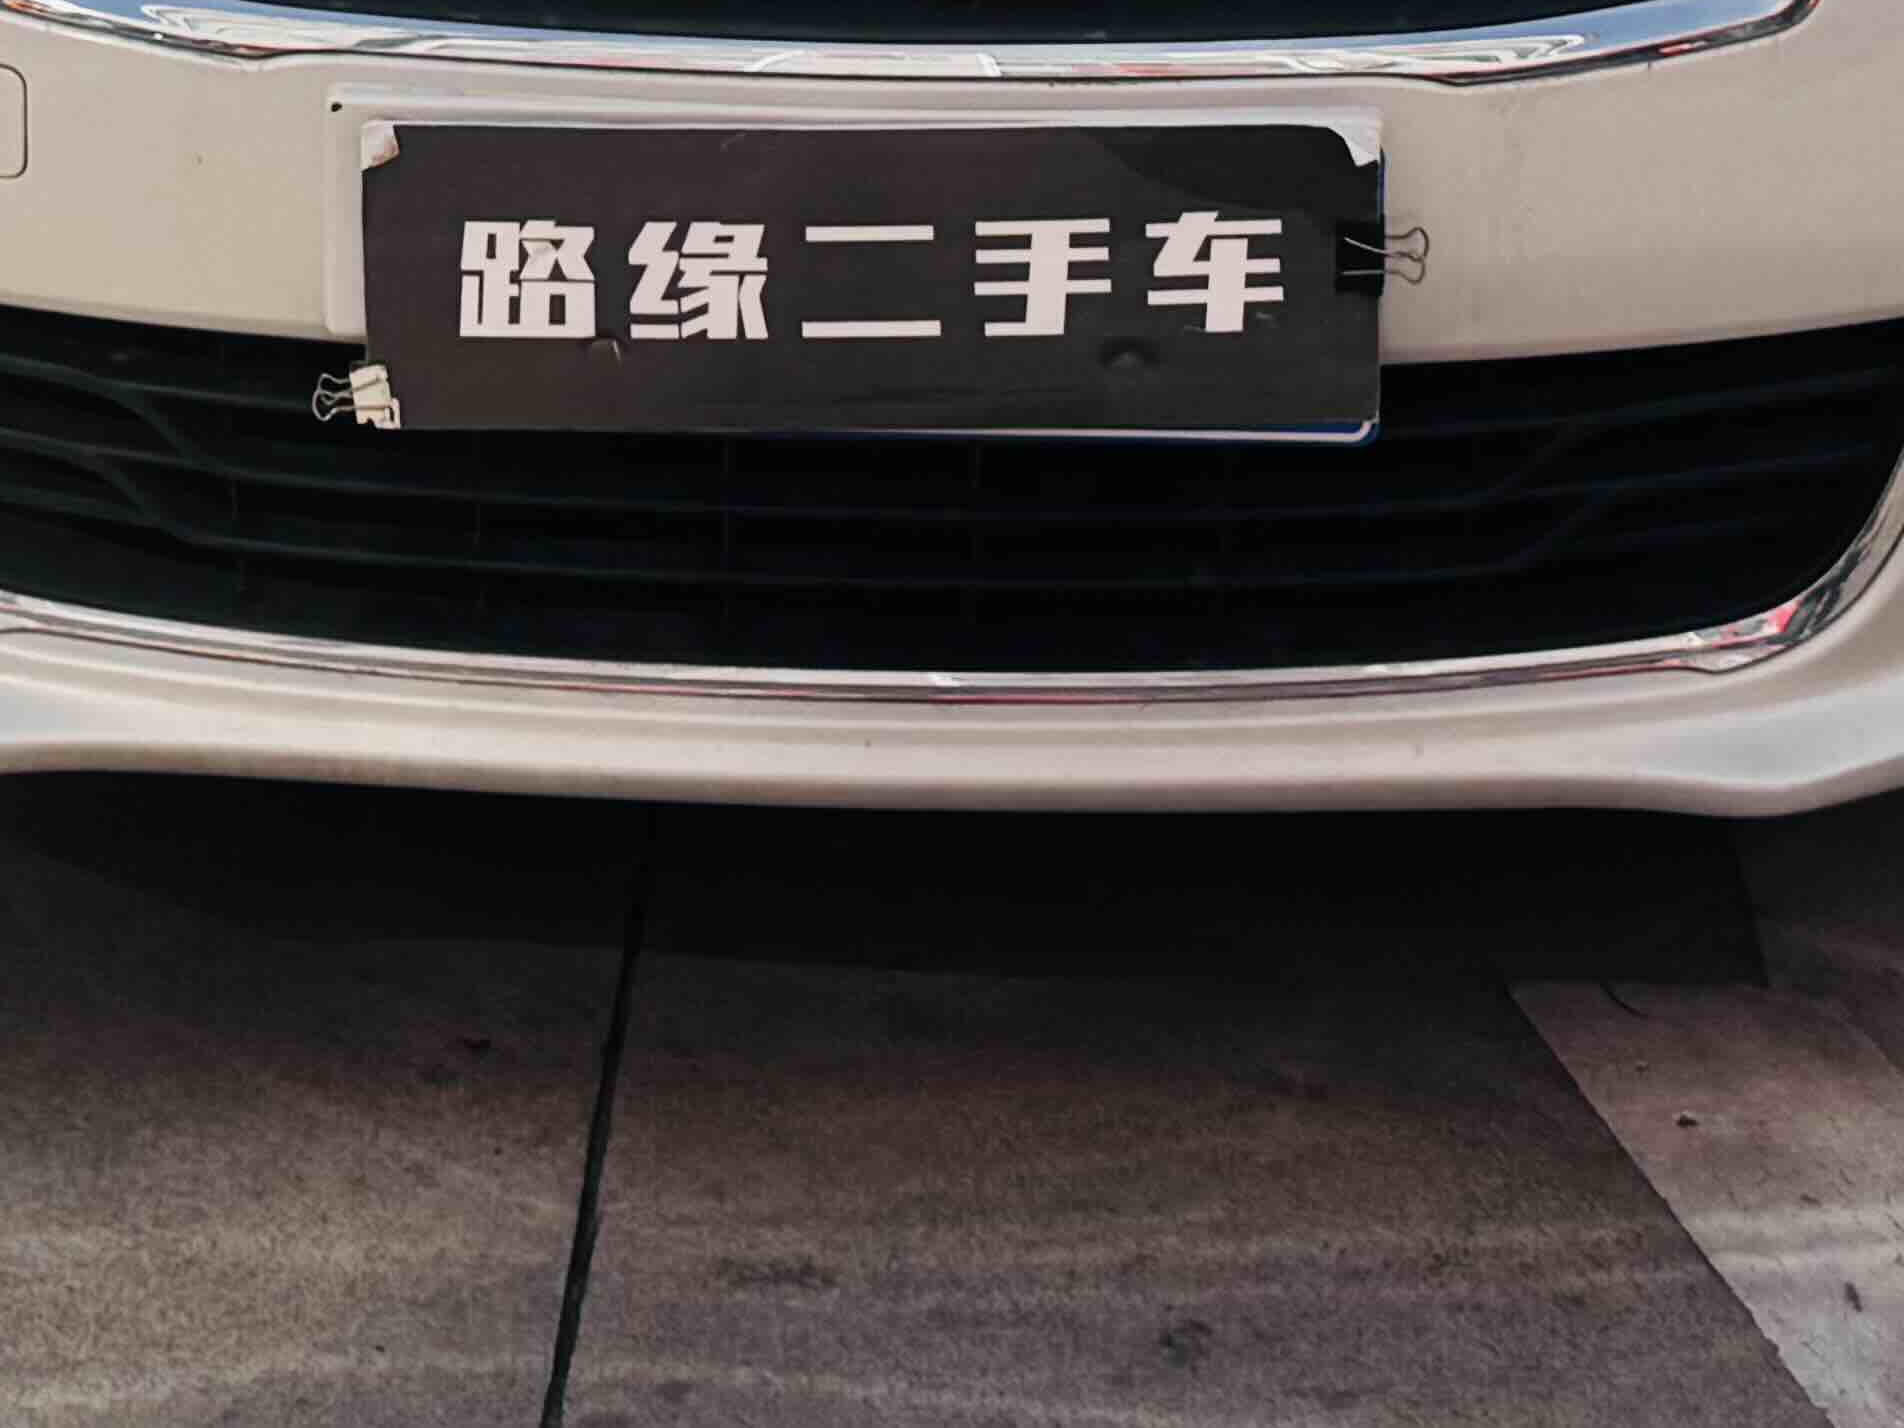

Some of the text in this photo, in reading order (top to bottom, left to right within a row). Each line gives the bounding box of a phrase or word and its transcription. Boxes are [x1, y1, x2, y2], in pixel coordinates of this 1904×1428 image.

[460, 212, 1283, 339] 路缘二手车
